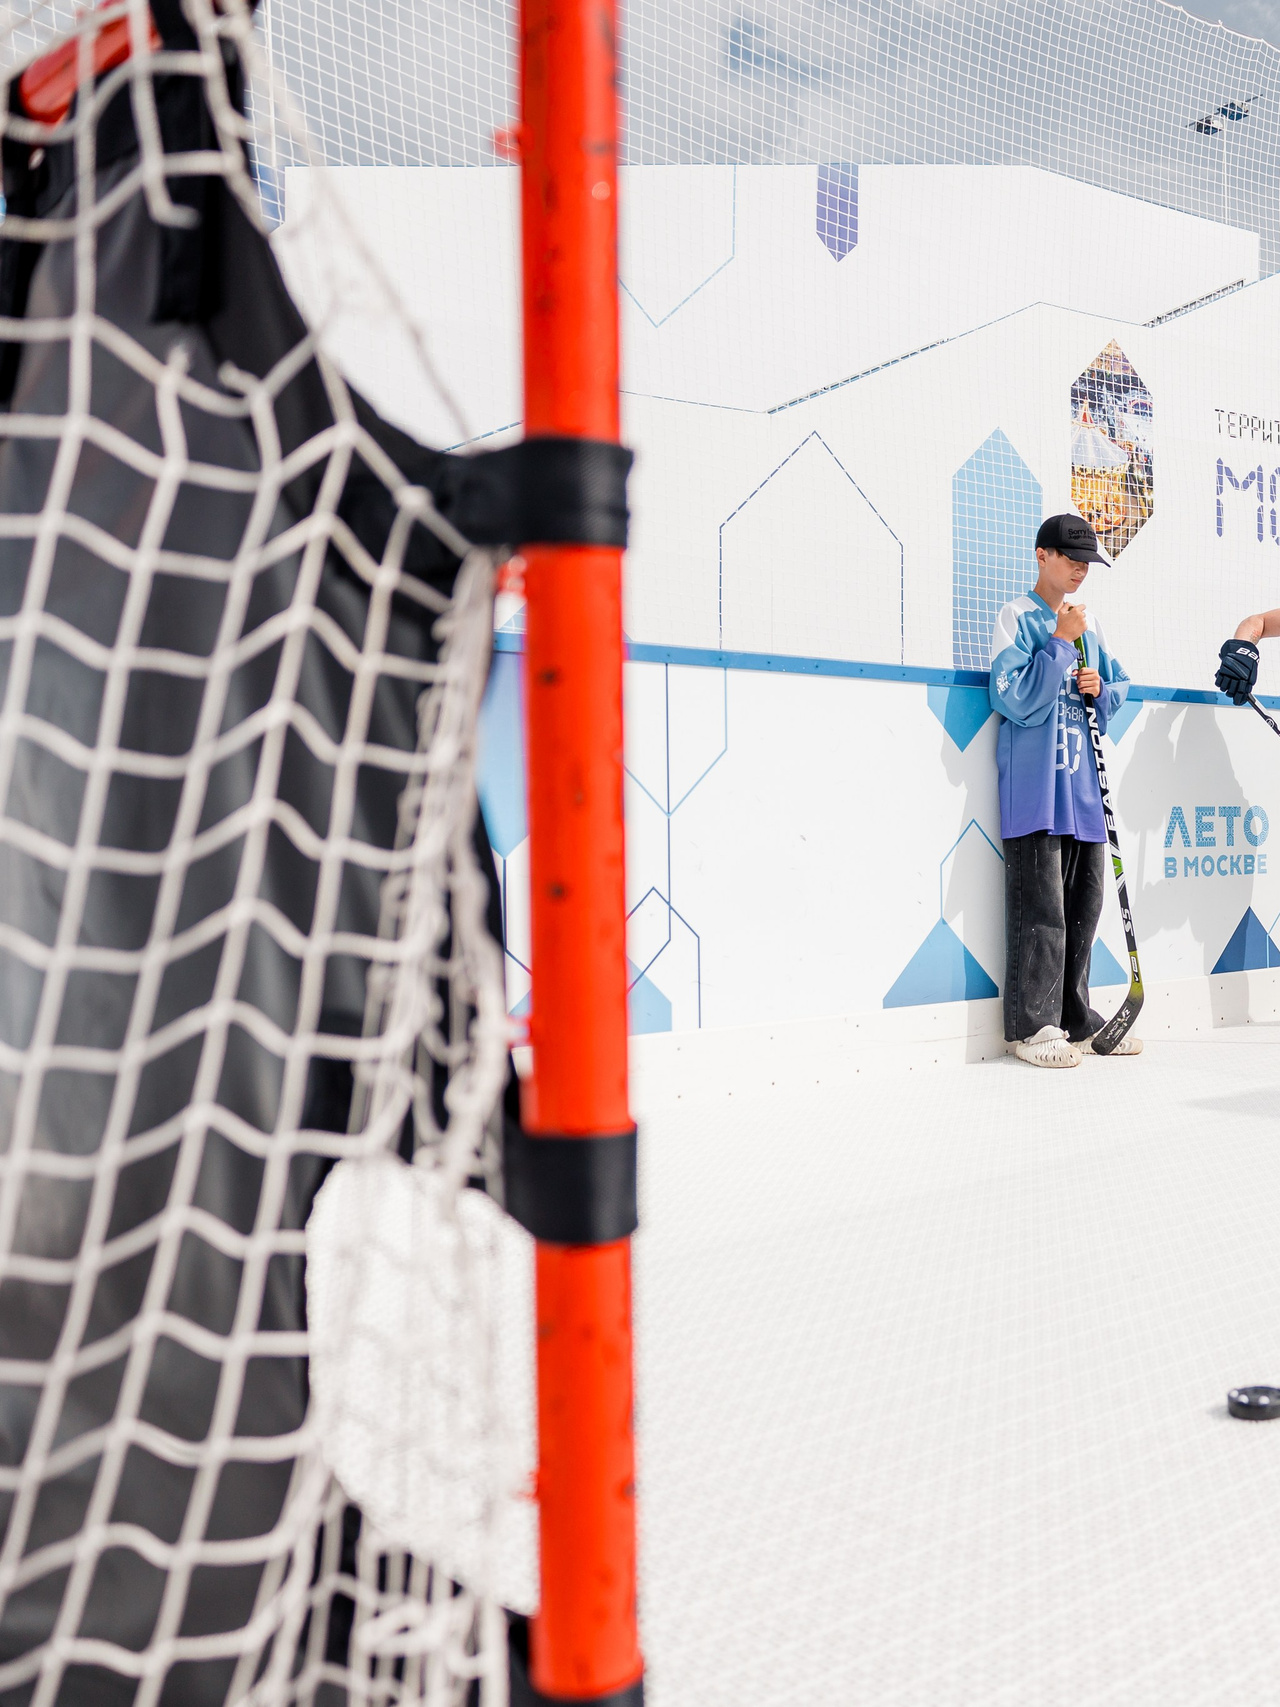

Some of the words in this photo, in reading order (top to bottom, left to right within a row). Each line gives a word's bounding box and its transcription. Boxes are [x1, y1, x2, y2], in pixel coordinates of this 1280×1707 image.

[1086, 706, 1116, 832] EASTON
[1163, 805, 1269, 848] ЛЕТО
[1164, 857, 1178, 878] В
[1184, 854, 1267, 877] МОСКВЕ
